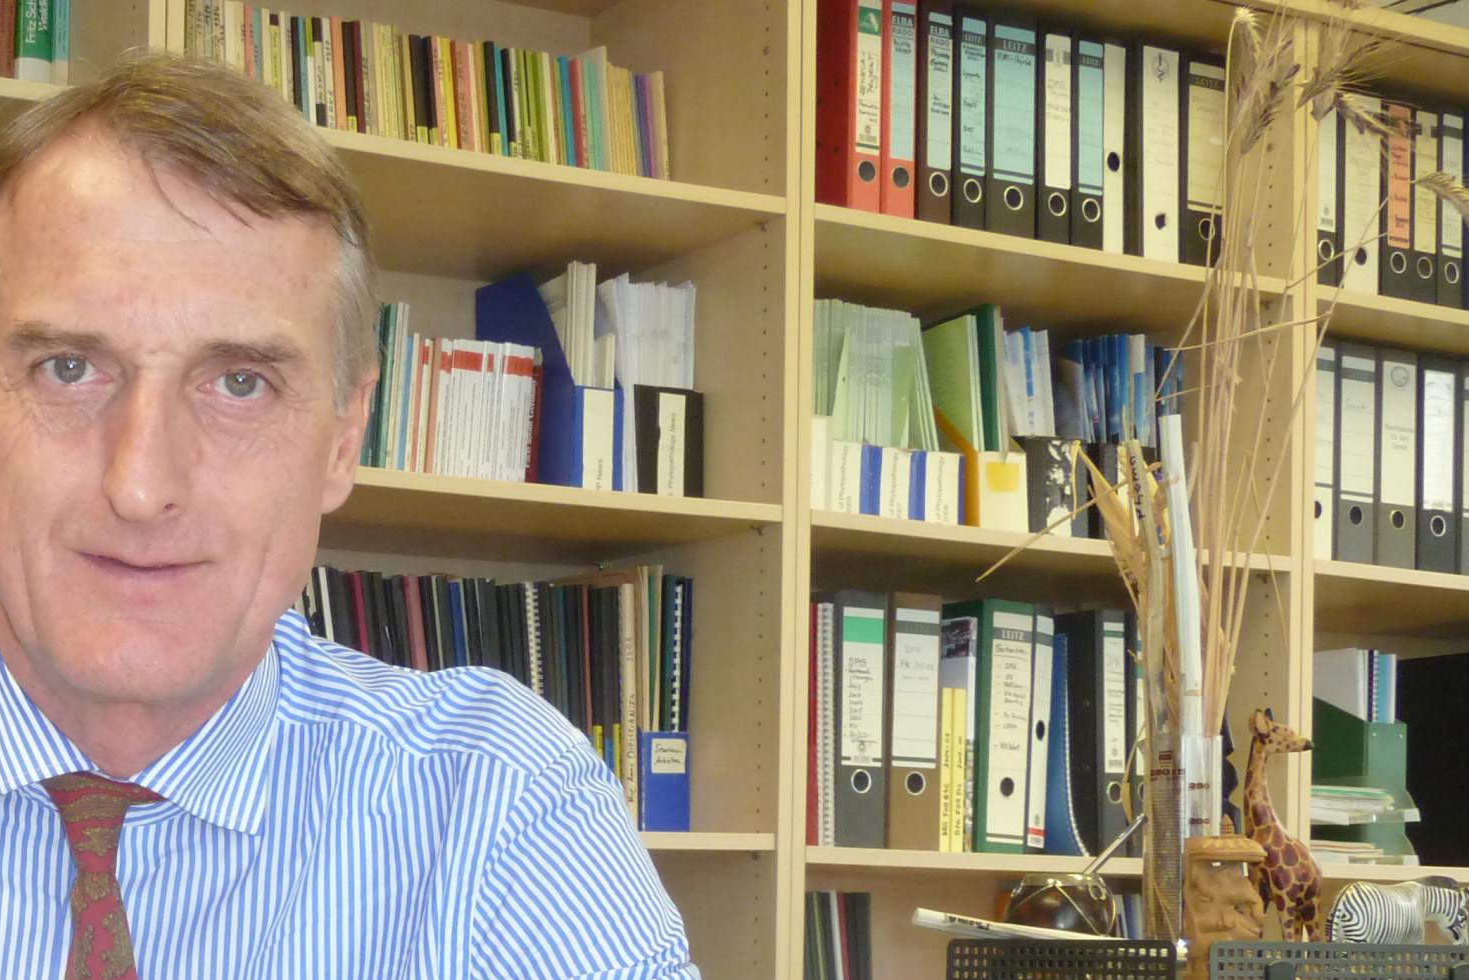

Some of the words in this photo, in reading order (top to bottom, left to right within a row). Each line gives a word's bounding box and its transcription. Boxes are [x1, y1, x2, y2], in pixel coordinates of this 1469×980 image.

[892, 15, 912, 27] ELBA
[930, 25, 949, 37] ELBA
[1003, 40, 1027, 51] LEITZ
[1002, 629, 1025, 640] LEITZ
